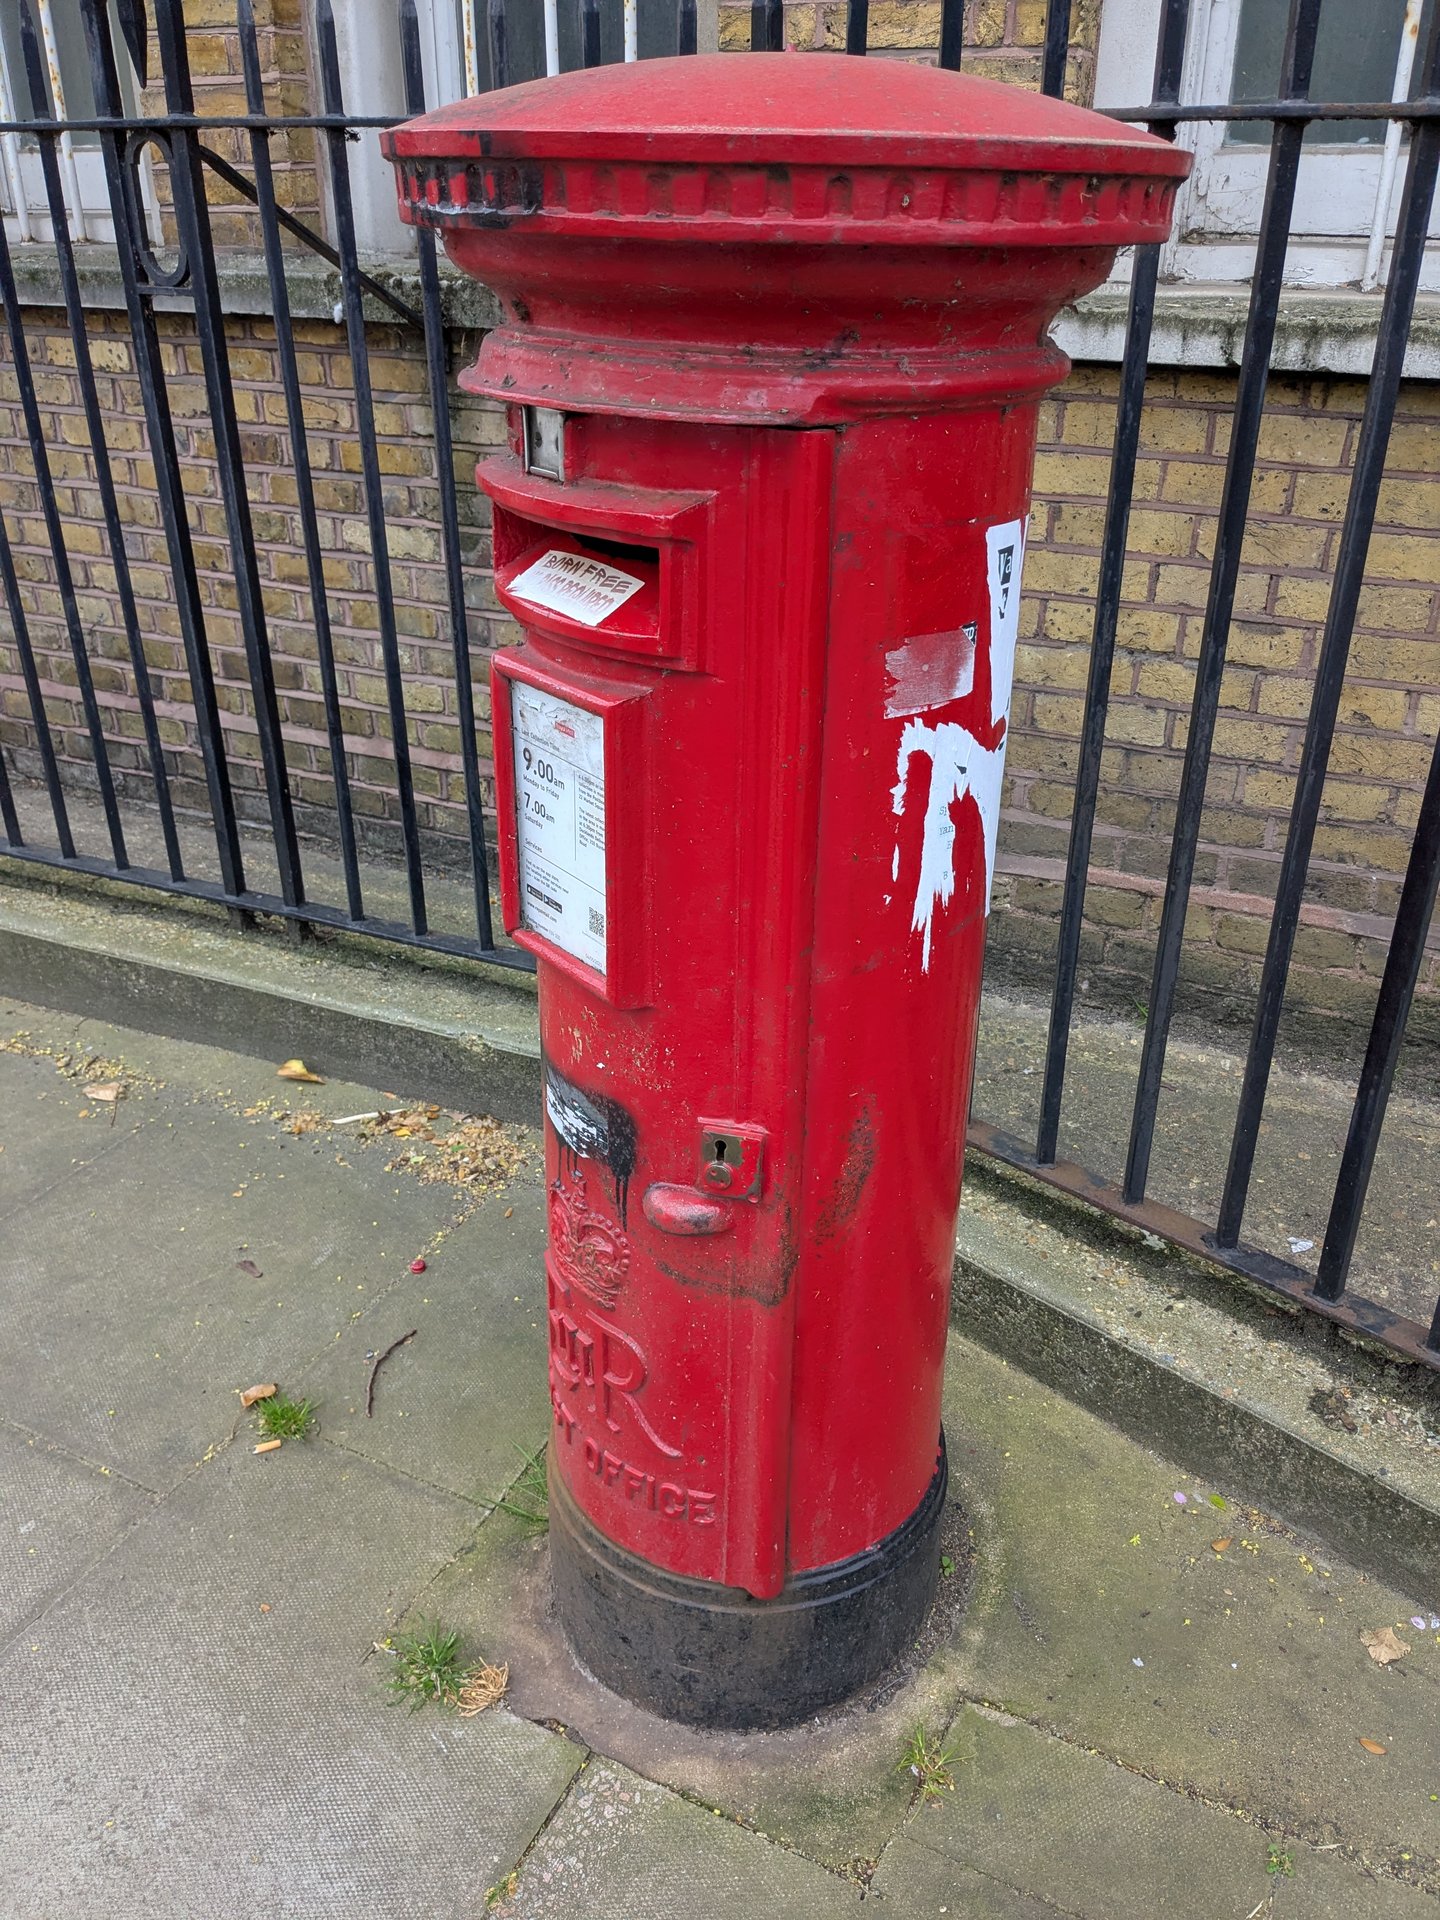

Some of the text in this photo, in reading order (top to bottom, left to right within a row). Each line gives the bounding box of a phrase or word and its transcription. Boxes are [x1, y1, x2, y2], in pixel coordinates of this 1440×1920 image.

[544, 554, 585, 575] BORN
[580, 563, 633, 594] FREE
[523, 773, 540, 790] Monday
[545, 786, 560, 801] Friday
[525, 813, 543, 830] Saturday
[525, 837, 543, 854] Services
[583, 1435, 717, 1525] OFFICE
